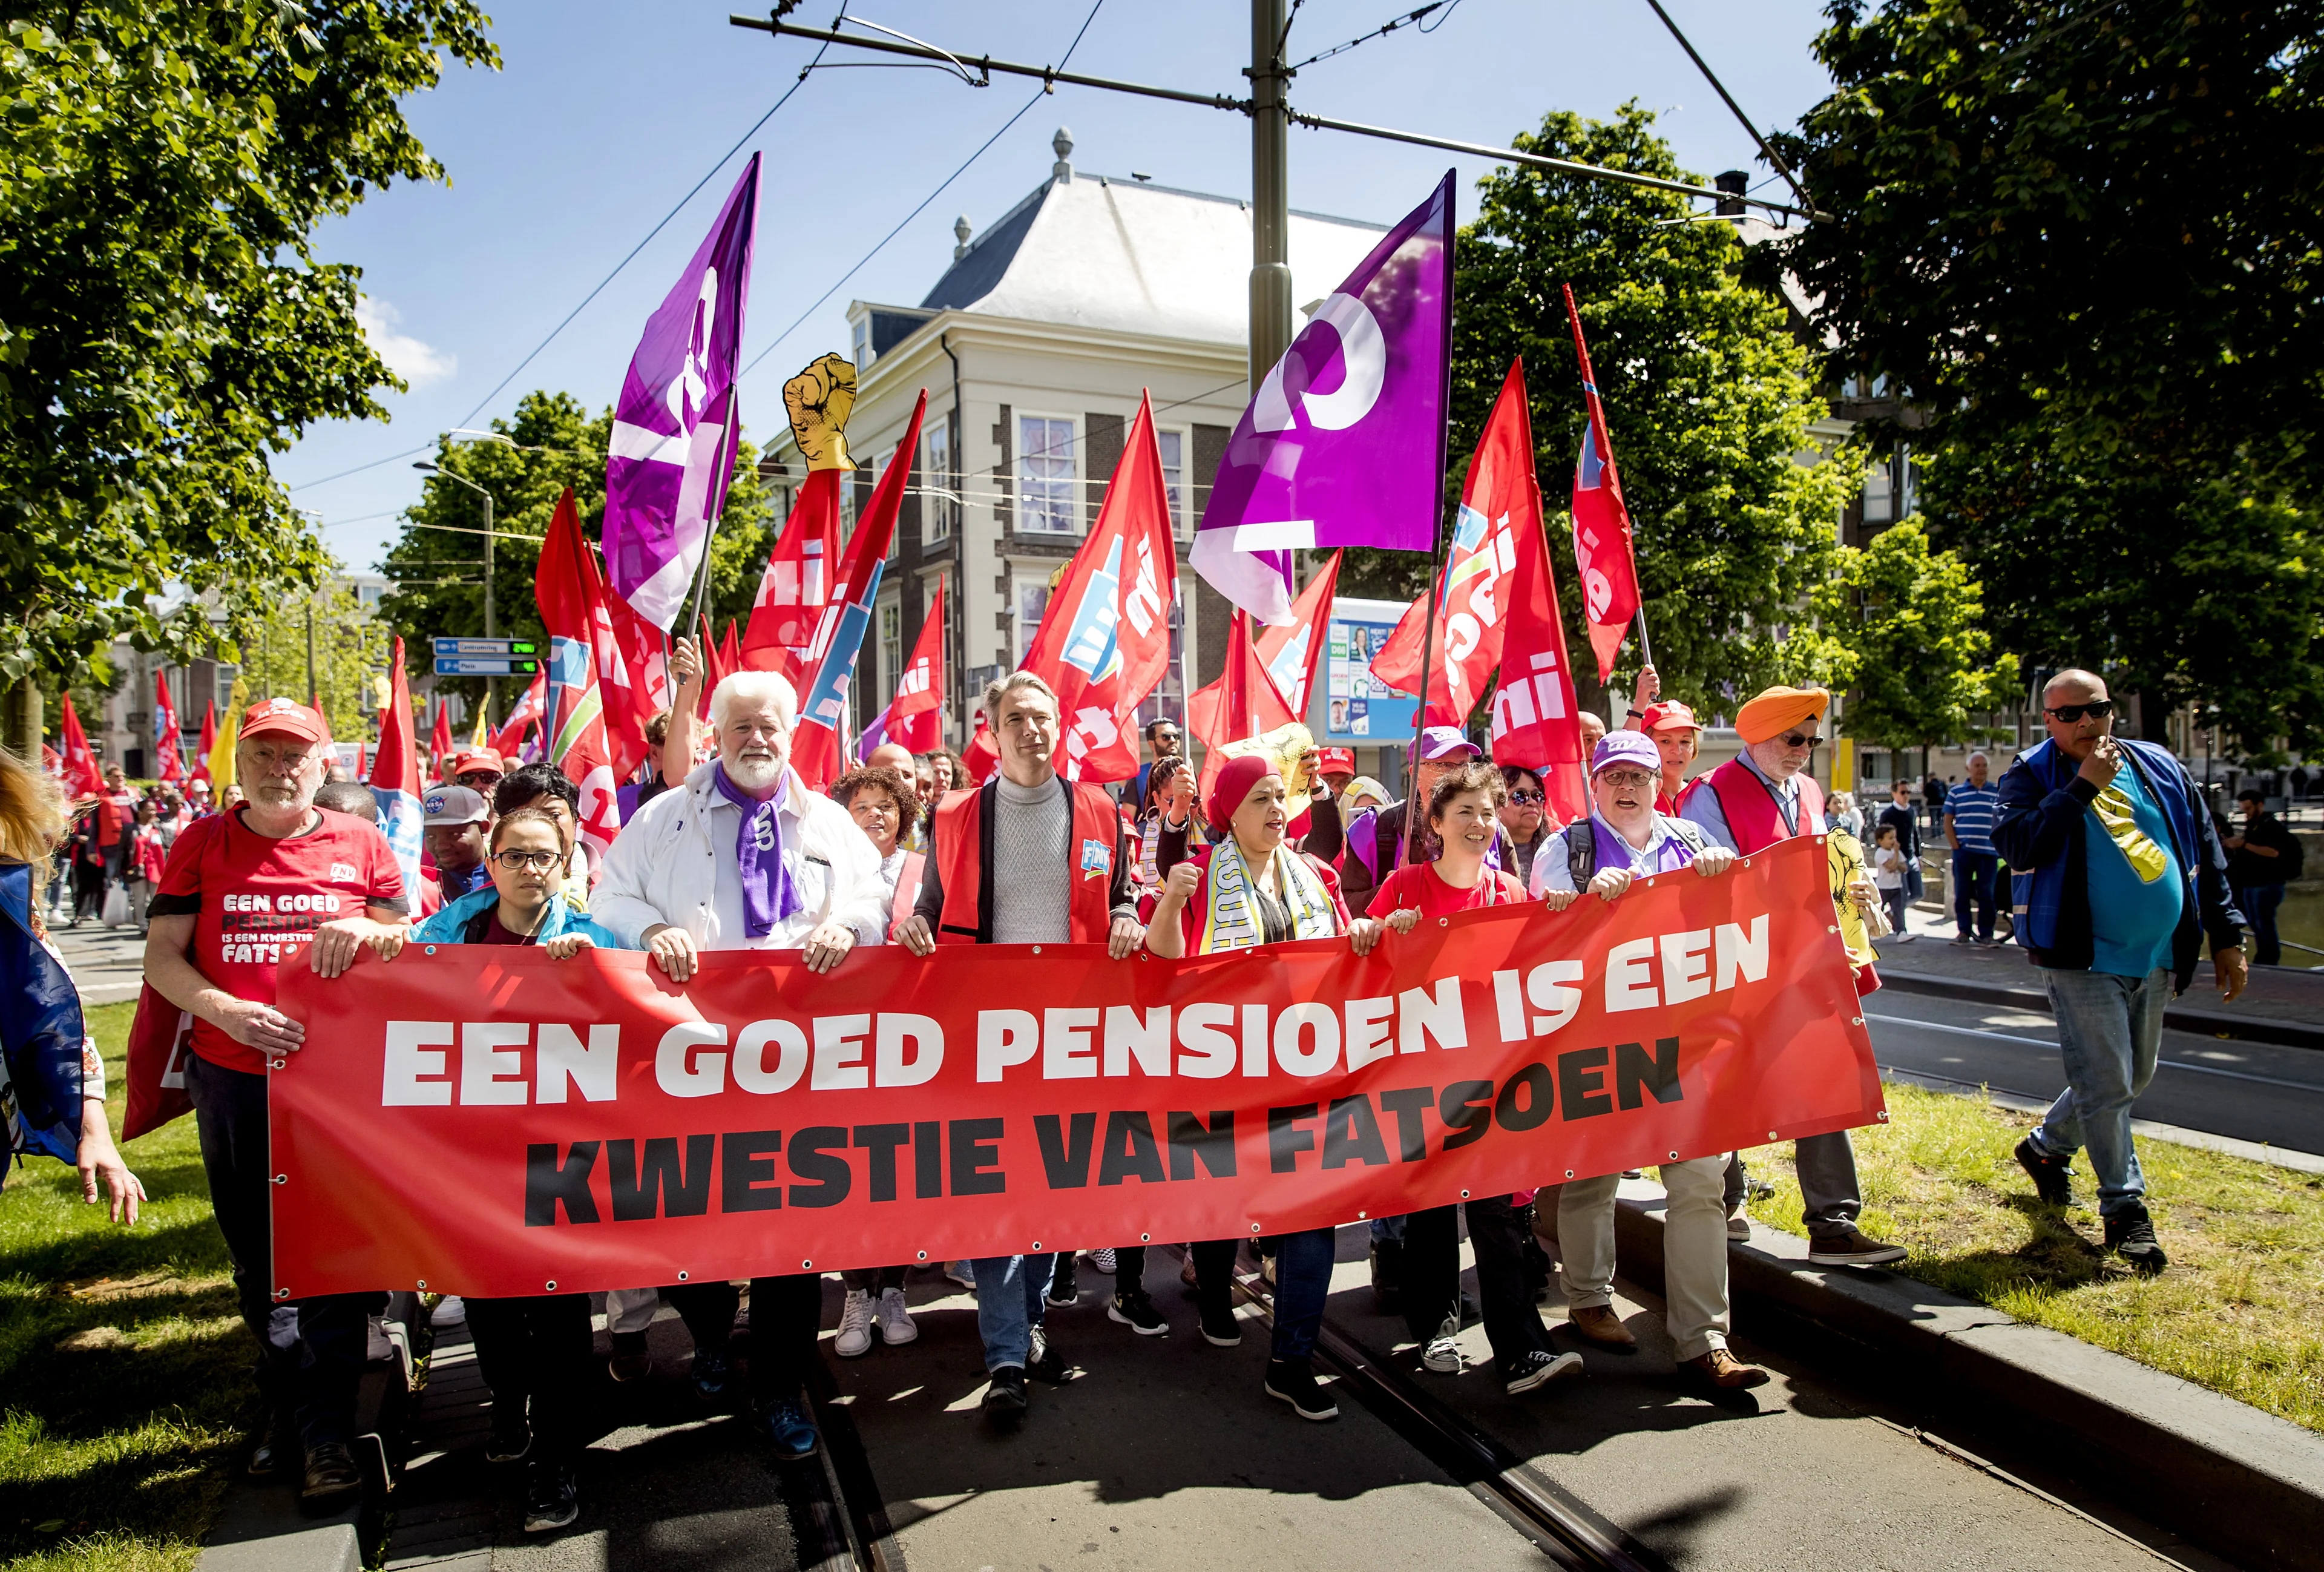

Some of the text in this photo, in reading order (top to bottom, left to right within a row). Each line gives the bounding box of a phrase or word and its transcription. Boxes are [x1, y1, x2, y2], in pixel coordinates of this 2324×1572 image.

[1331, 645, 1347, 655] D66
[1083, 846, 1109, 866] FNV
[332, 866, 355, 877] FNV
[223, 894, 340, 913] EEN GOED
[222, 933, 313, 942] IS EEN KWESTIE
[382, 913, 1770, 1107] EEN GOED PENSIOEN IS EEN
[524, 1036, 1684, 1227] KWESTIE VAN FATSOEN
